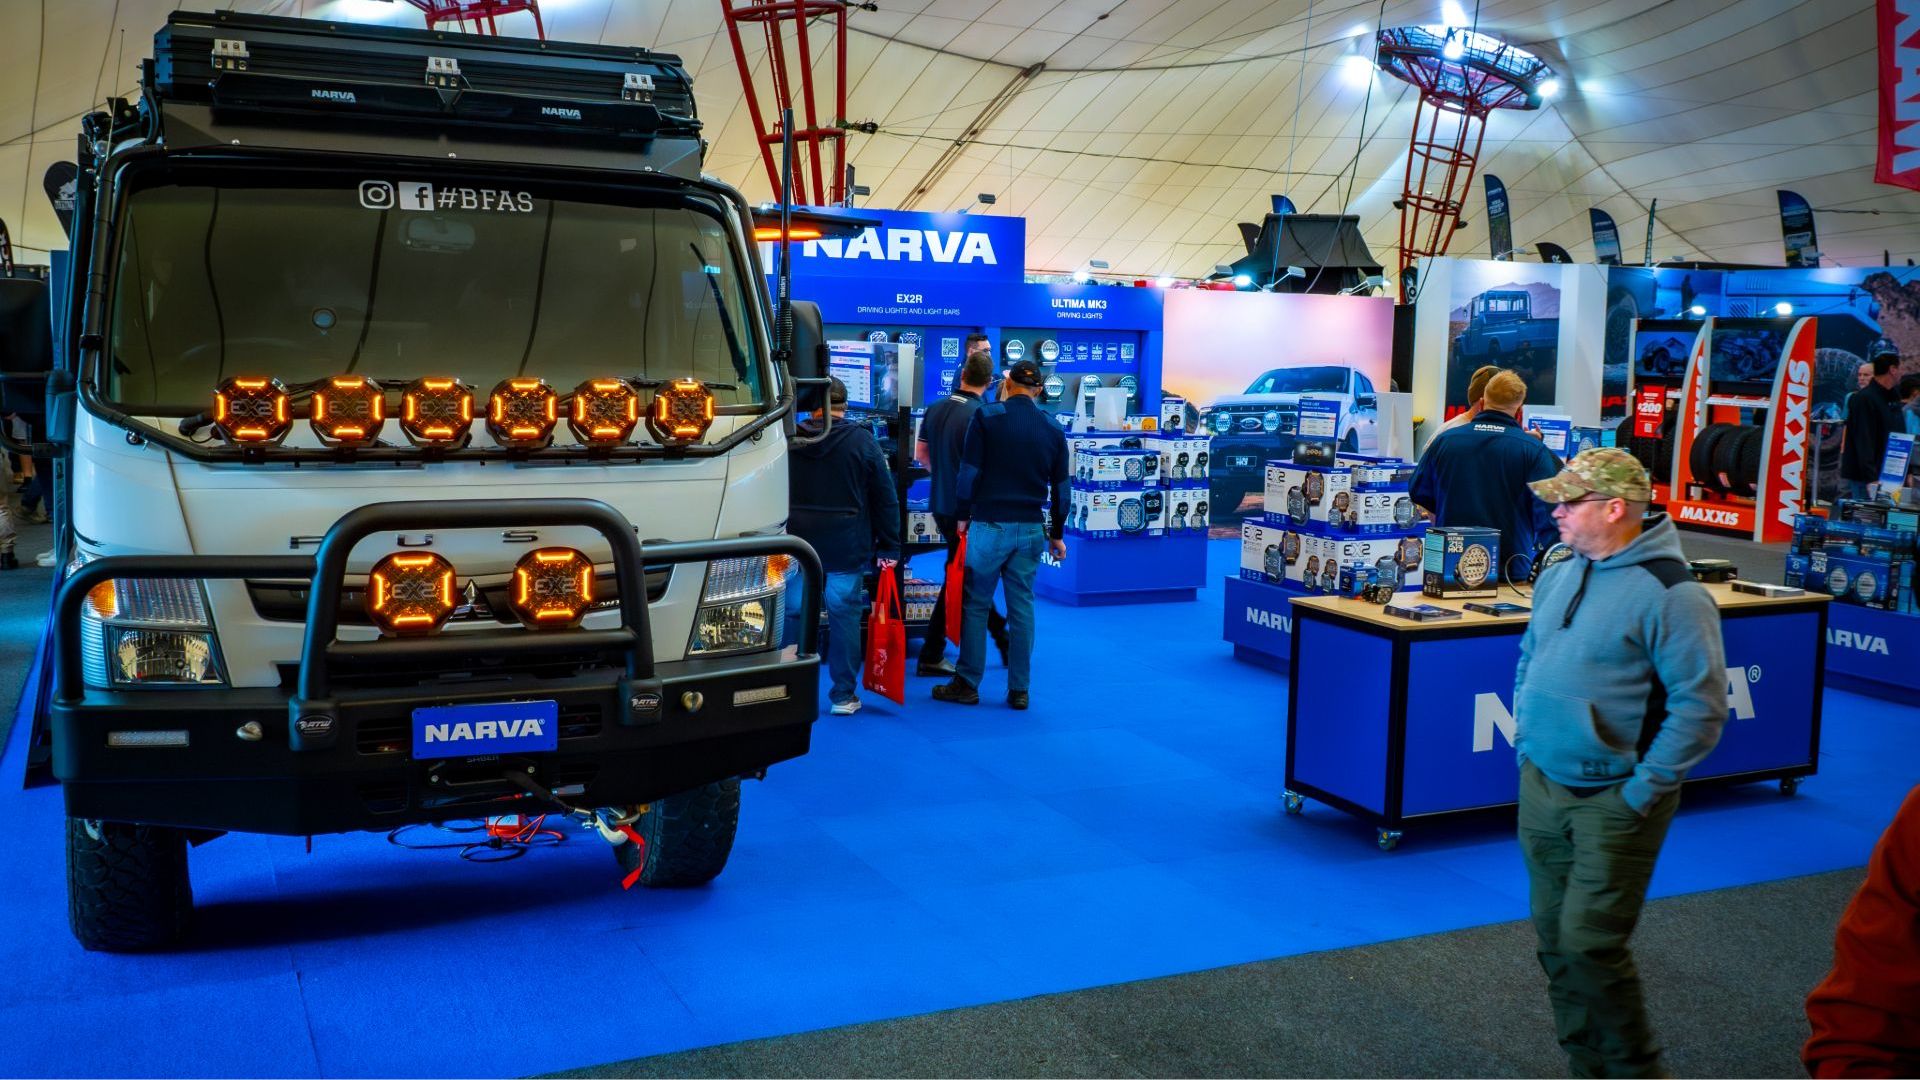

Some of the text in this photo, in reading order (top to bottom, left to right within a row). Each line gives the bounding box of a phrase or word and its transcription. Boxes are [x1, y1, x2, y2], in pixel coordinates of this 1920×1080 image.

[312, 89, 356, 101] NARVA
[542, 106, 581, 118] NARVA
[437, 186, 533, 213] #BFAS
[896, 293, 923, 304] EX2R
[1051, 298, 1108, 310] ULTIMA MK3
[857, 306, 884, 314] DRIVING
[908, 307, 923, 315] AND
[943, 308, 961, 316] BARS
[1056, 311, 1103, 320] DRIVING LIGHTS
[231, 401, 273, 417] EX2
[329, 401, 369, 415] EX2
[420, 401, 458, 416] EX2
[1637, 402, 1662, 414] $200
[1778, 359, 1811, 527] MAXXIS
[1267, 468, 1286, 484] EX2
[1364, 495, 1391, 508] EX2
[1679, 505, 1739, 526] MAXXIS
[1244, 526, 1263, 541] EX2
[1344, 542, 1371, 558] EX2
[391, 581, 437, 600] EX2
[534, 577, 577, 595] EX2
[1246, 606, 1293, 634] NARV
[1826, 627, 1890, 656] ARVA
